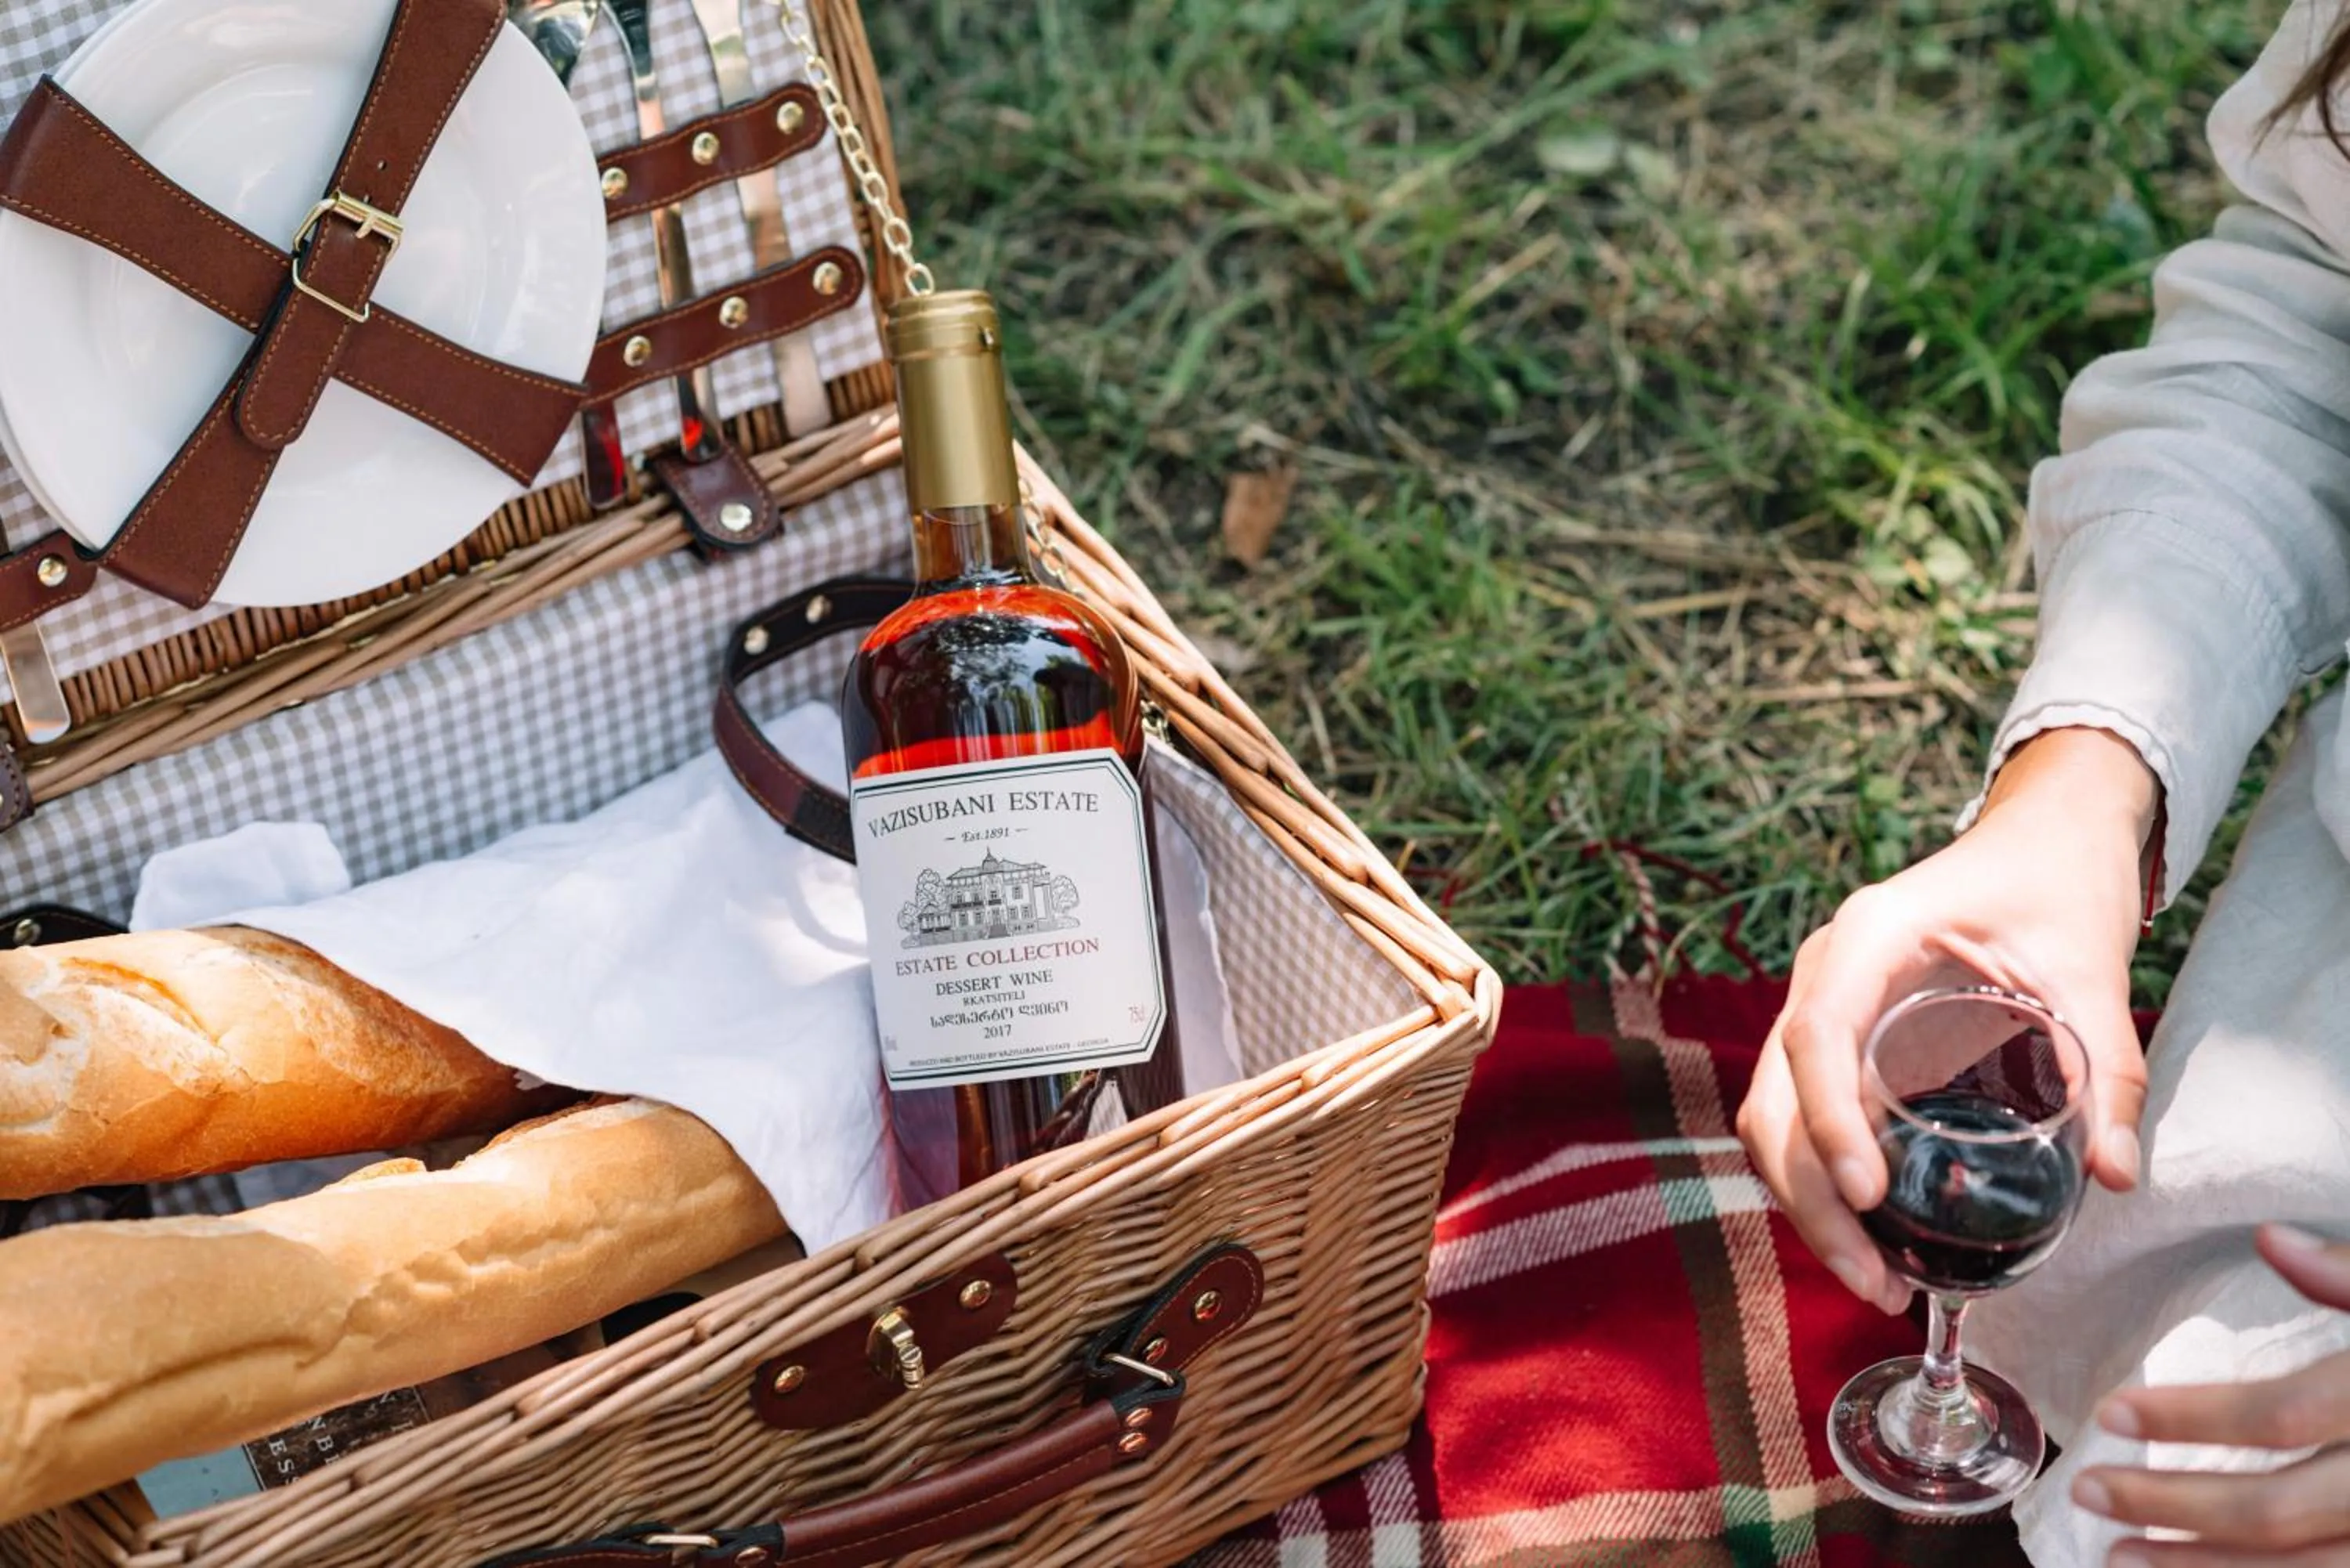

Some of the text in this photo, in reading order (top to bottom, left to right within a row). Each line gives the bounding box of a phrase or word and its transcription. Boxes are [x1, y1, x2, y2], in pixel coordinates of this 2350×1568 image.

[868, 791, 1098, 838] VAZISUBANI ESTATE
[895, 938, 1100, 977] ESTATE COLLECTION
[936, 969, 1053, 995] DESSERT WINE
[984, 1024, 1011, 1039] 2017
